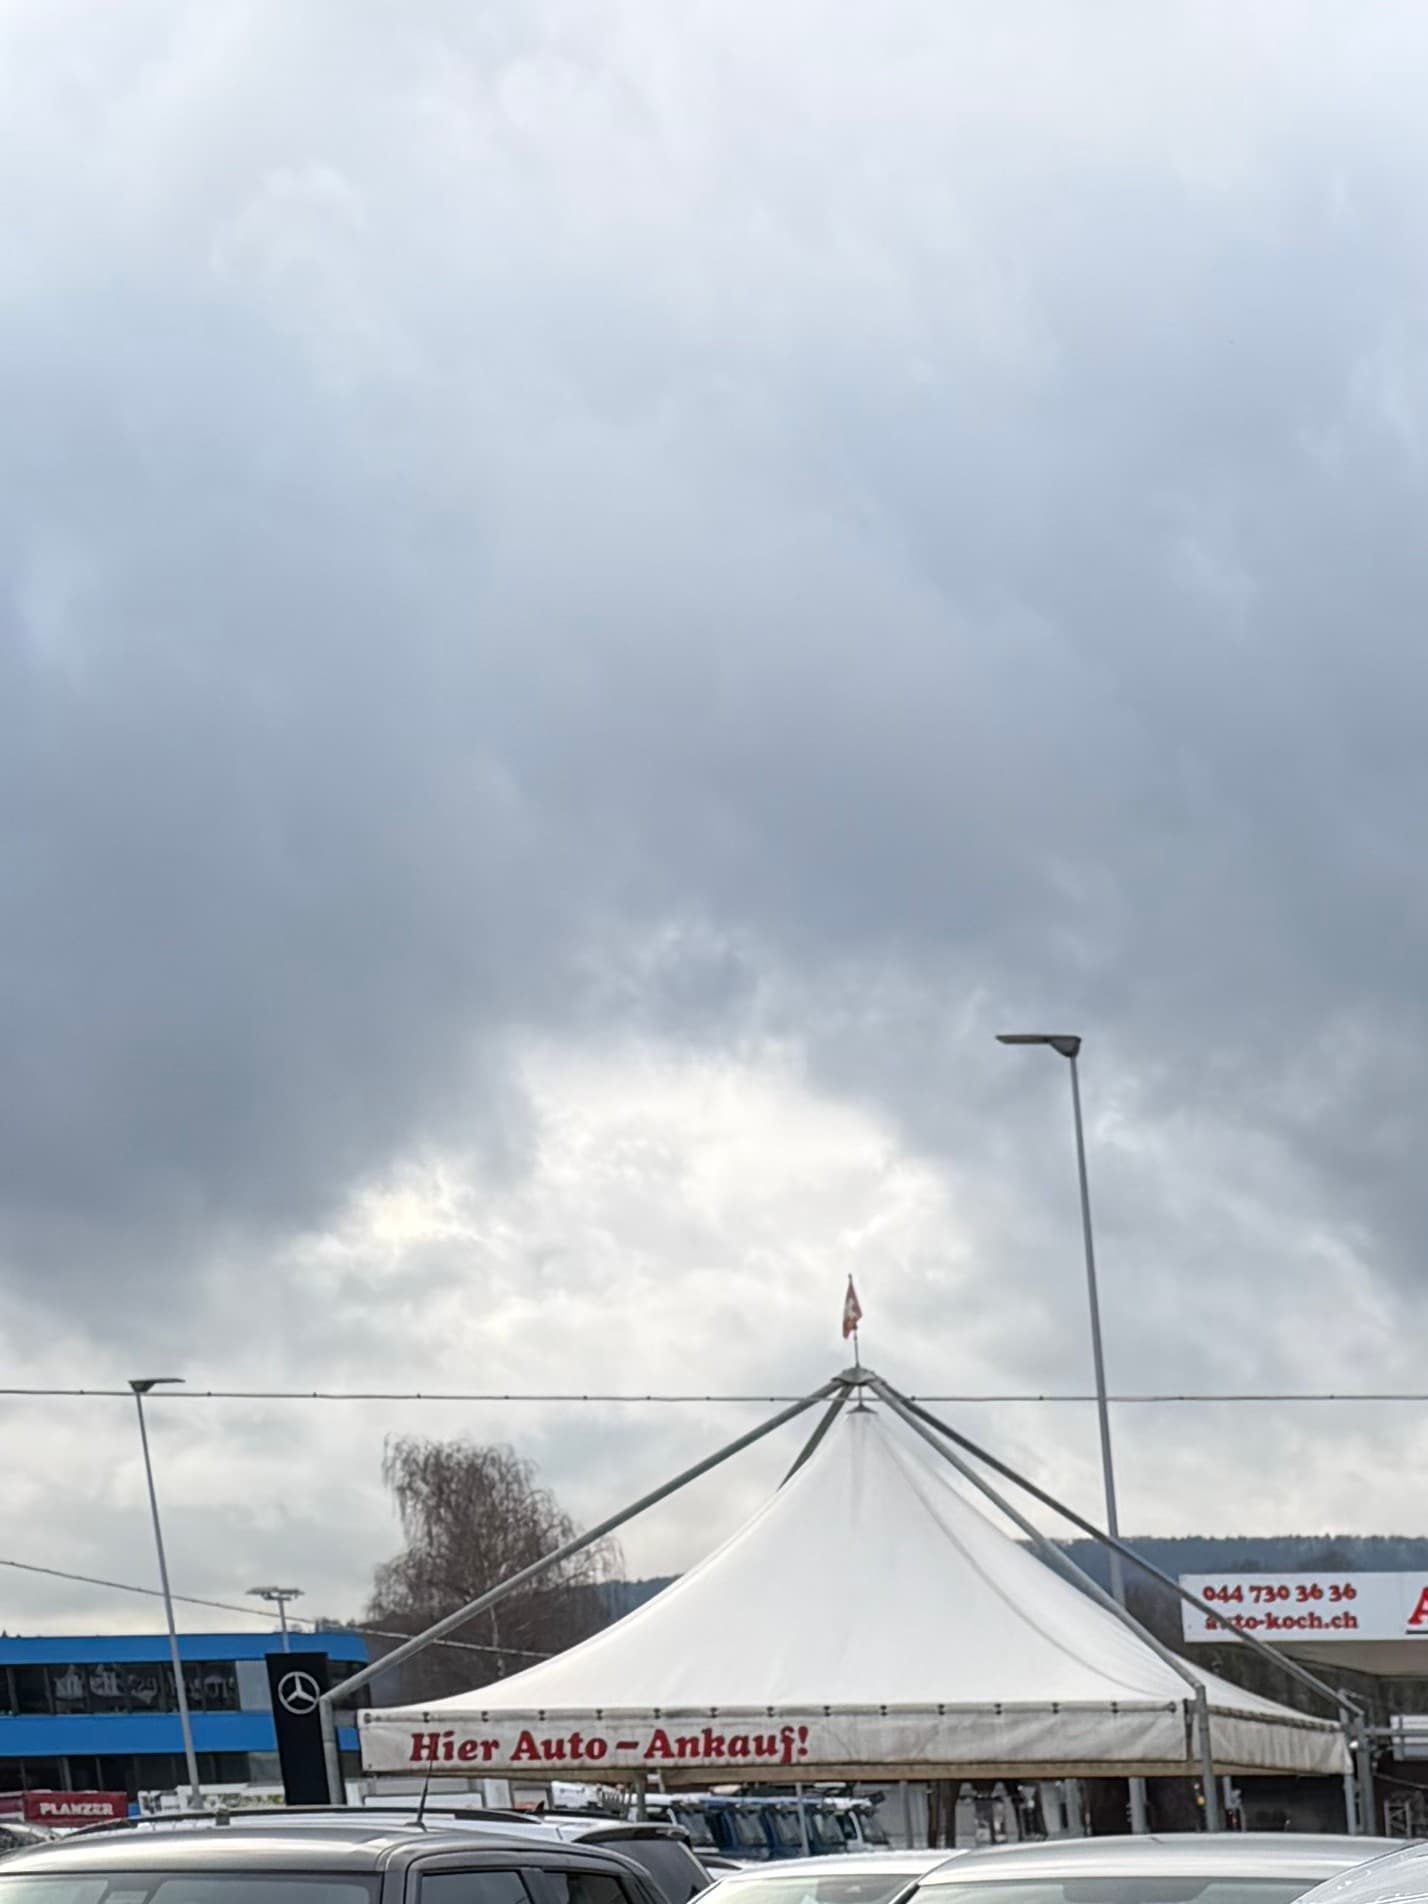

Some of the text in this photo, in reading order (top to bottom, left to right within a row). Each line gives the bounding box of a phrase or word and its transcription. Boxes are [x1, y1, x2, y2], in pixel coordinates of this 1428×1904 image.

[1202, 1583, 1357, 1603] 044 730 36 36
[409, 1731, 500, 1762] Hier
[40, 1803, 113, 1816] PLANZER
